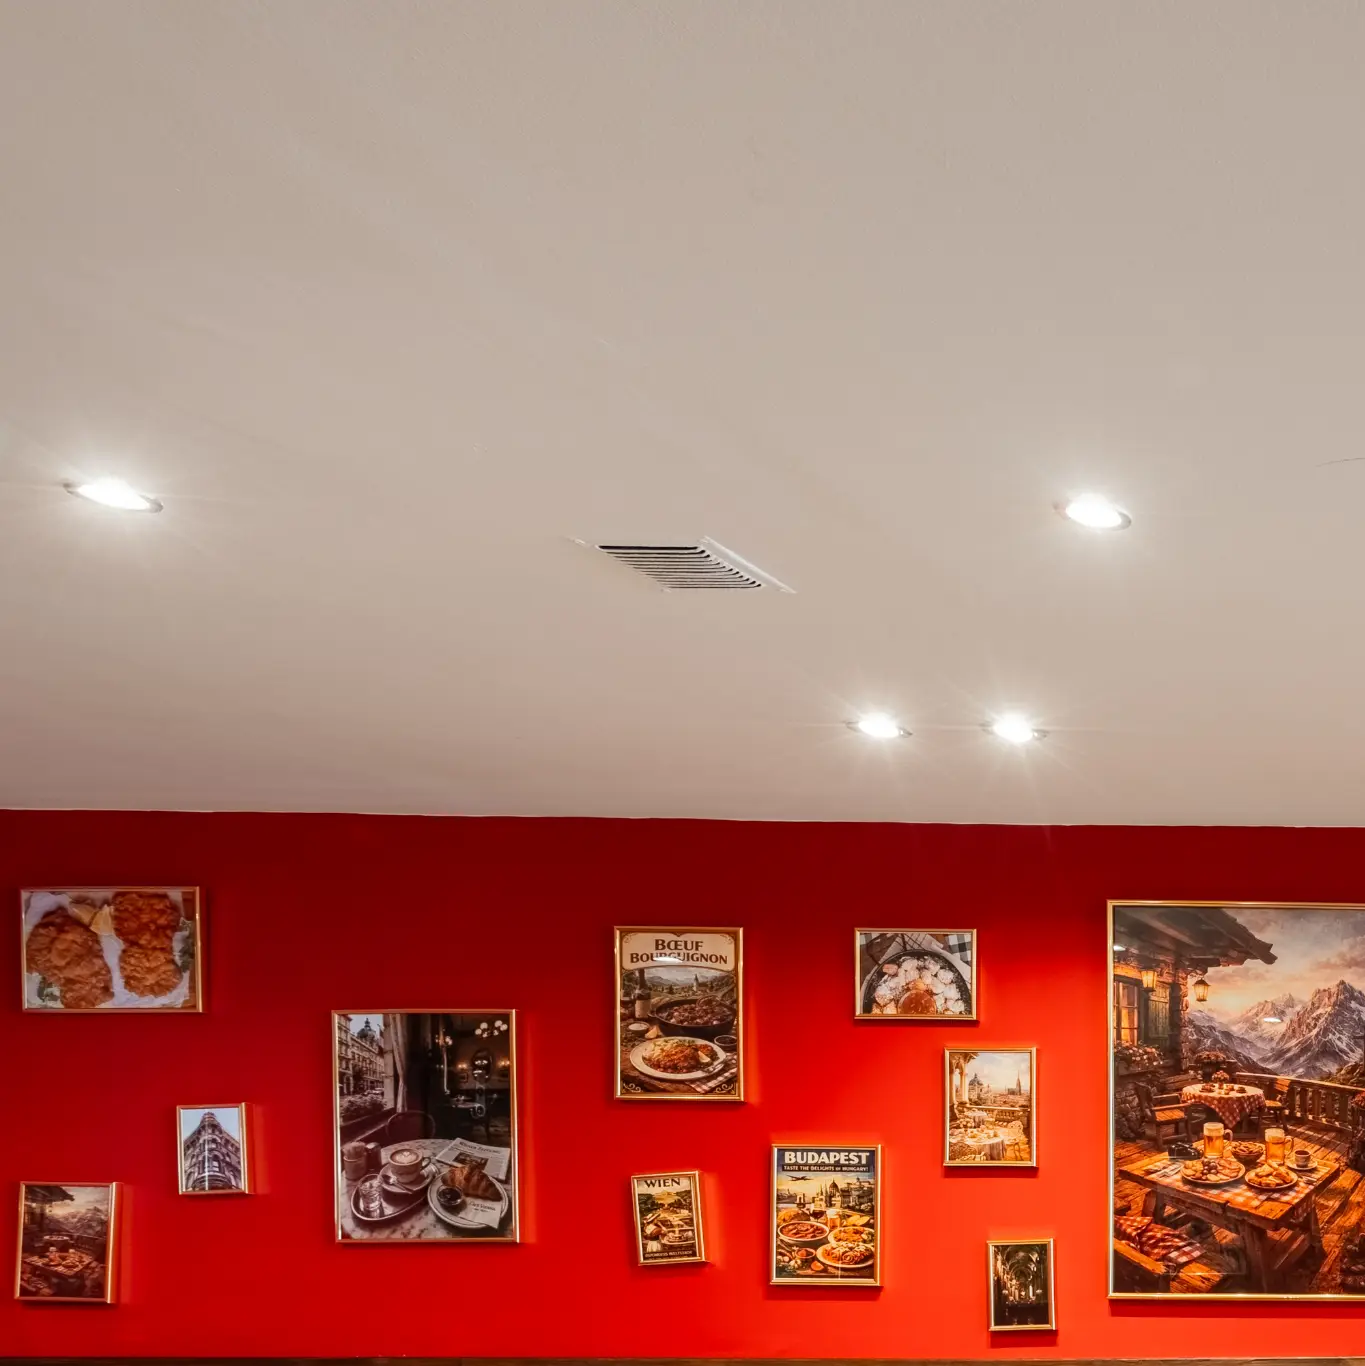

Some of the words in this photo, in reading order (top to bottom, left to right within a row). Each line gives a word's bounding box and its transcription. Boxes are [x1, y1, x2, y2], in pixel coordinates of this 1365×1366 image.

[654, 938, 704, 952] BŒUF
[784, 1151, 870, 1164] BUDAPEST
[644, 1177, 681, 1188] WIEN
